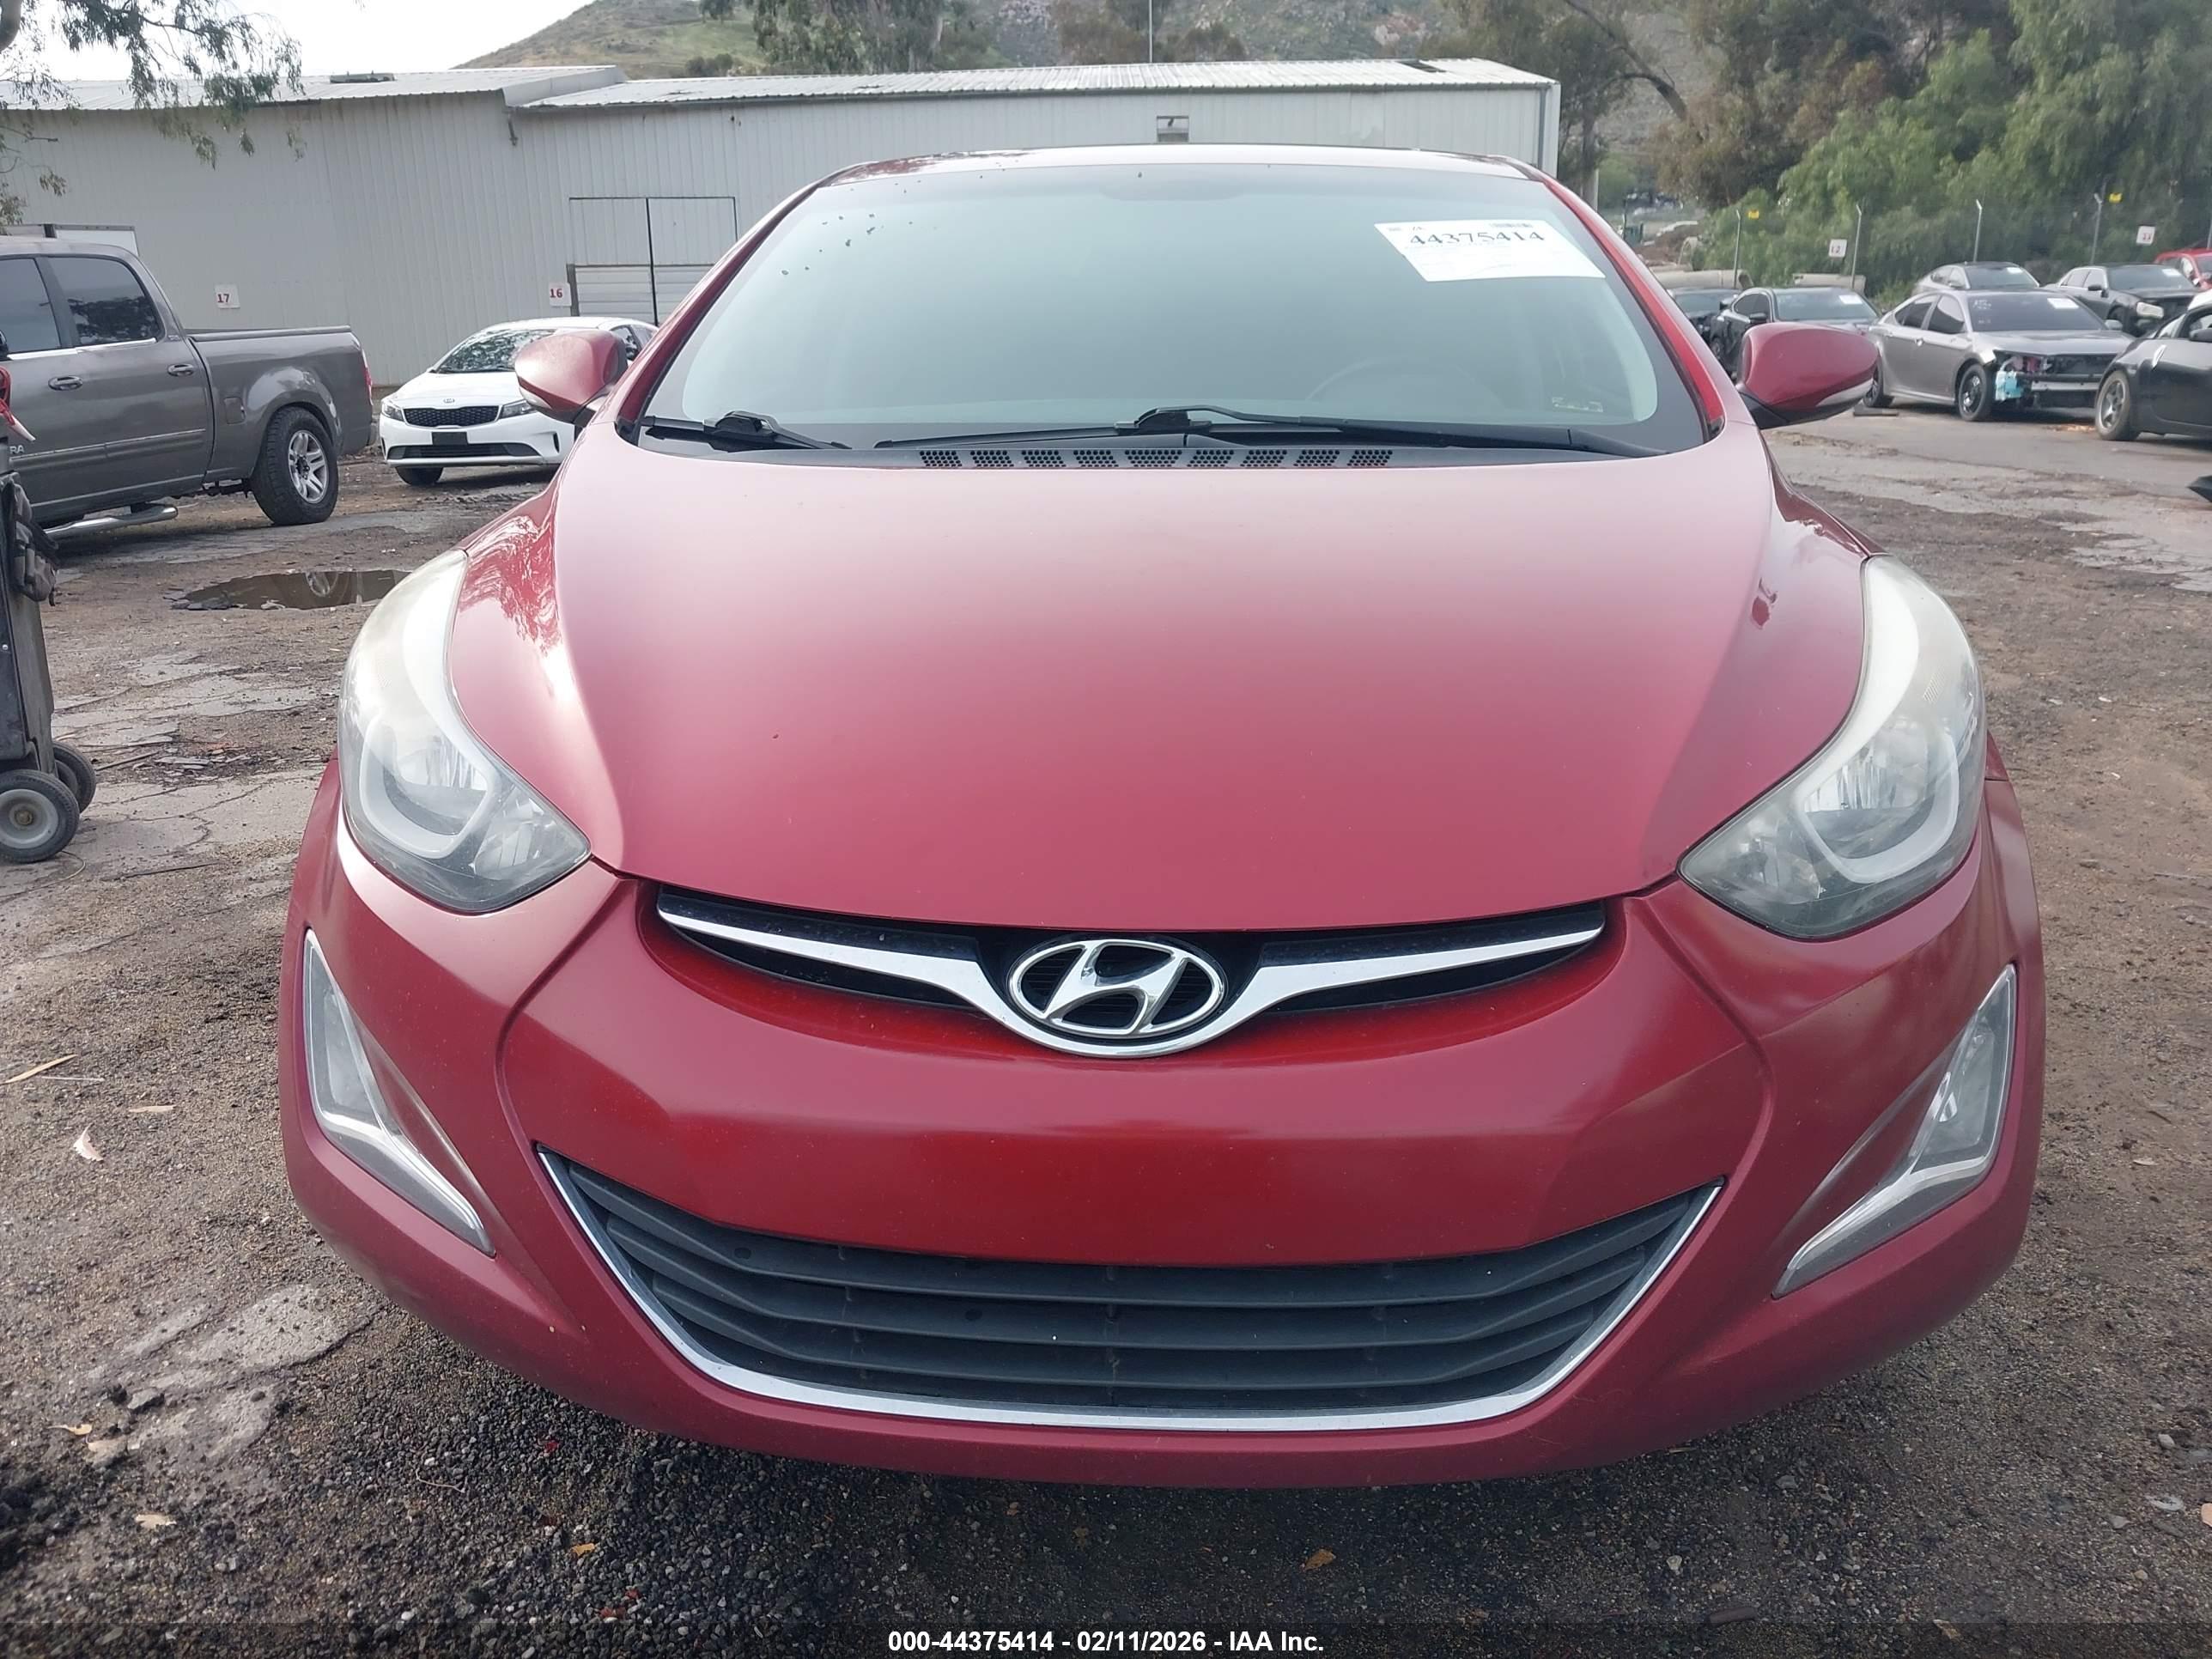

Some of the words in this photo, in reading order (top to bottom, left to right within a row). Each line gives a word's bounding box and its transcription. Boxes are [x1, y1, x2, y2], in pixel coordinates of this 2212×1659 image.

[1410, 231, 1545, 244] 44375414
[217, 293, 229, 303] 17
[550, 288, 563, 298] 16
